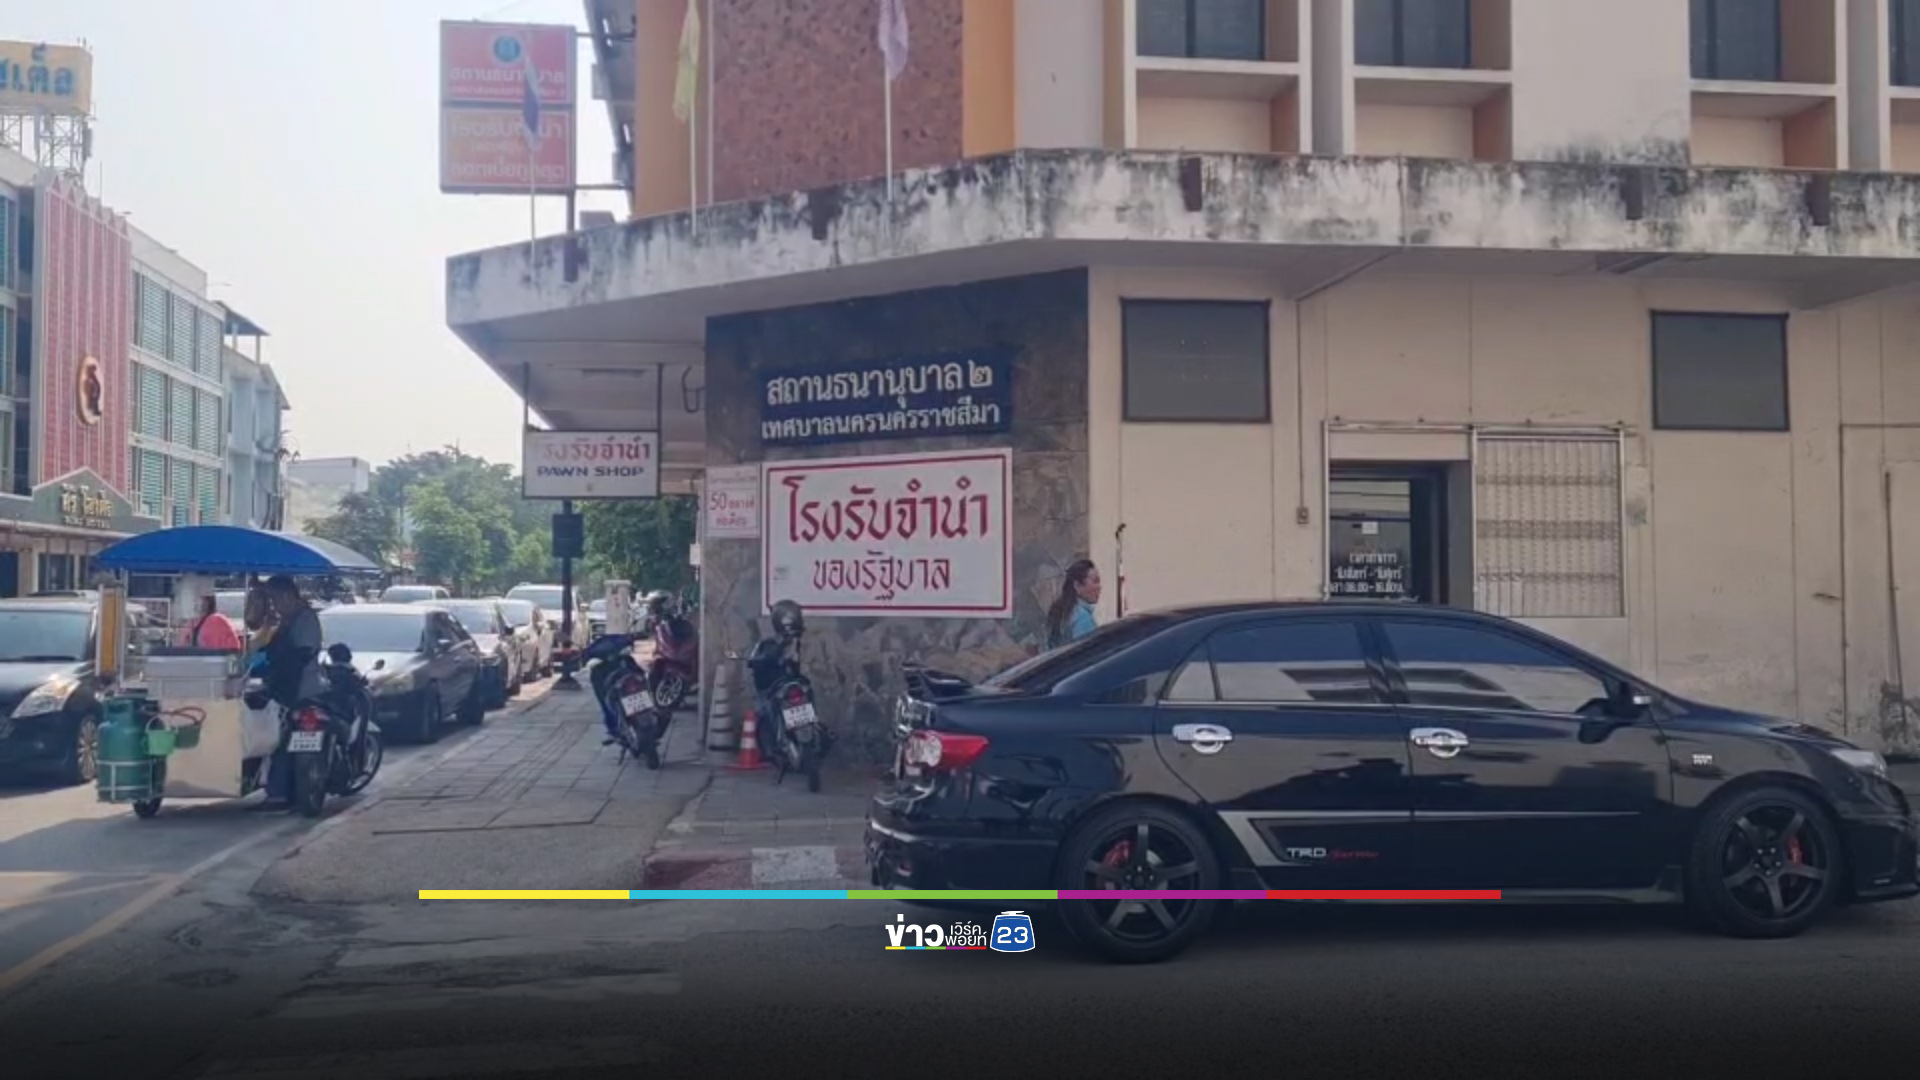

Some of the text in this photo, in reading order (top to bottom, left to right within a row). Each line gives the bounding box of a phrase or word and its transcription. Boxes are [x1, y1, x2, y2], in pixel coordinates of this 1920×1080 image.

[767, 360, 993, 408] สถานธนานุบาล ๒
[761, 397, 1000, 440] เทศบาลนครนครราชสีมา
[537, 466, 644, 477] PAWN SHOP
[710, 492, 727, 511] 50
[782, 475, 988, 542] โรงรับจำนำ
[812, 550, 950, 600] ของรัฐบาล
[1286, 847, 1327, 858] TRD
